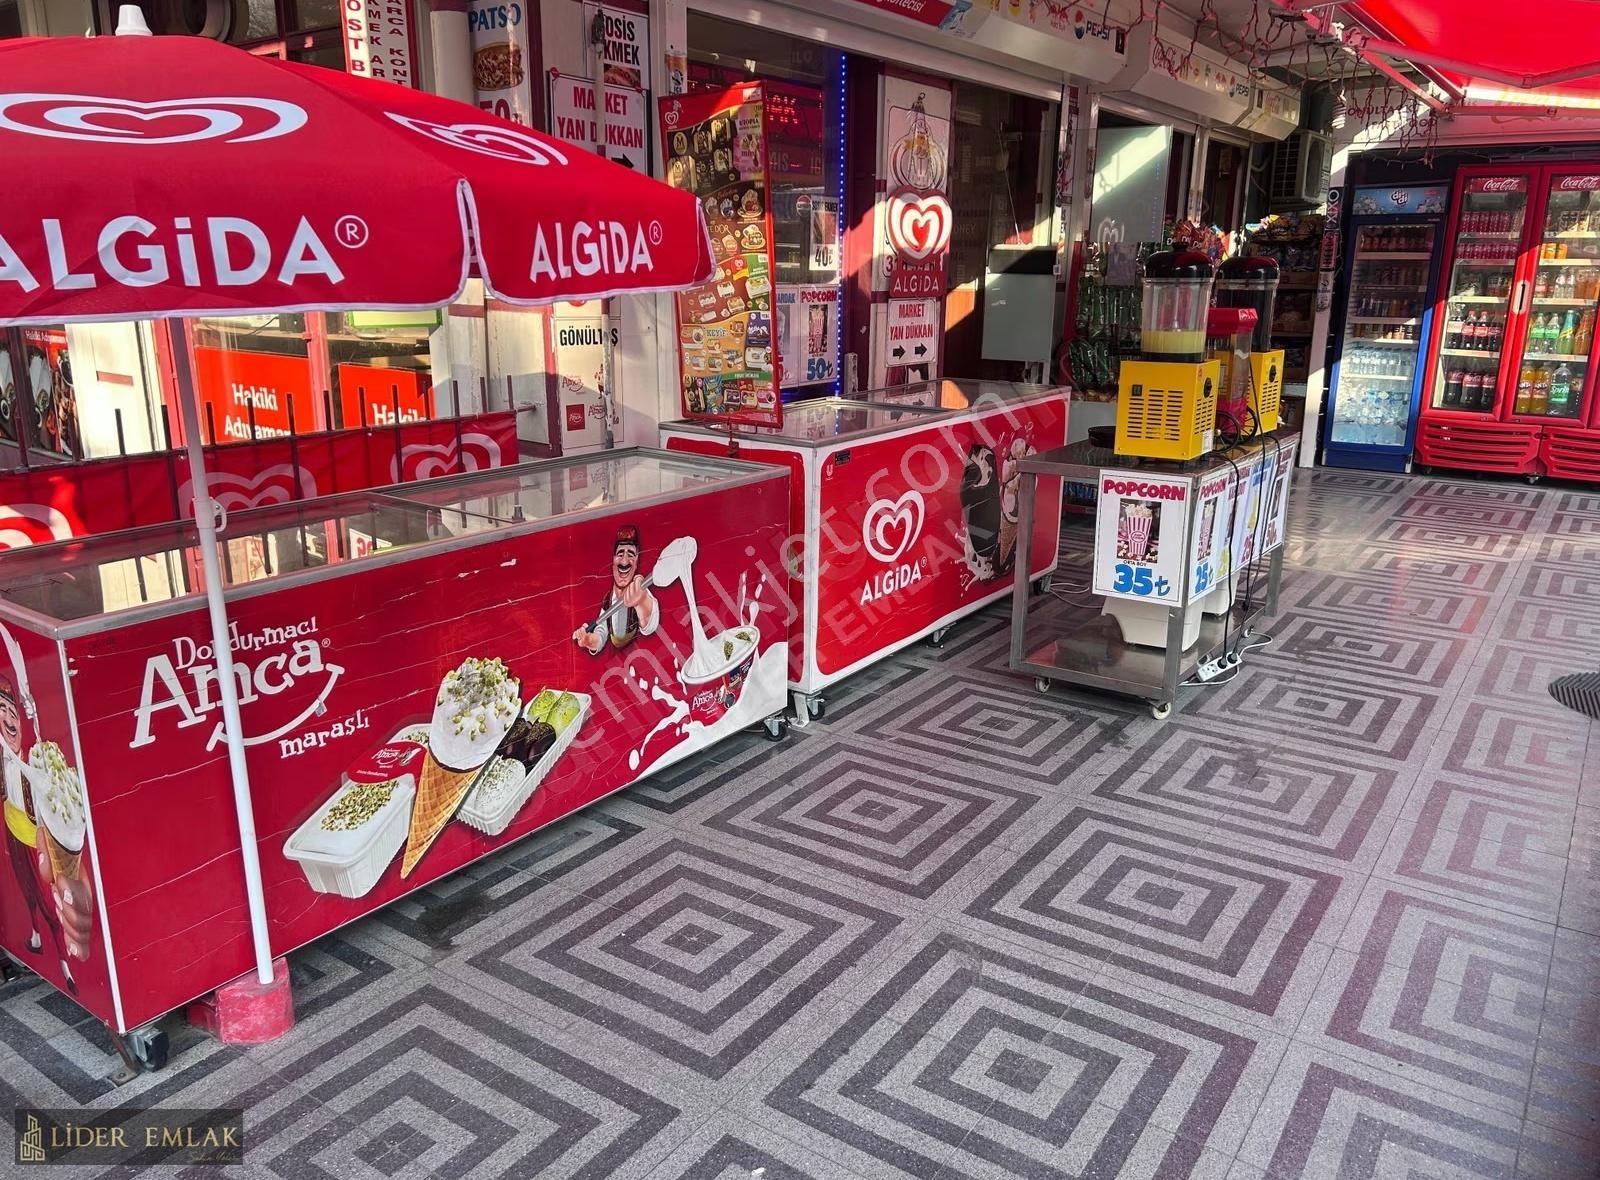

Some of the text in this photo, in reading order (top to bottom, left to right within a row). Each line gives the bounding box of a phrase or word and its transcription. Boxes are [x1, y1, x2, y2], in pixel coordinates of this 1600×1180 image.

[468, 3, 521, 32] PATSO
[604, 16, 635, 41] OSİS
[1086, 21, 1111, 40] PEPSI
[604, 40, 640, 65] KMEK
[573, 86, 628, 115] MAKET
[557, 117, 643, 148] YAN DKKAN
[801, 290, 837, 303] POPCORN
[899, 304, 925, 318] MARKET
[559, 325, 618, 347] GÖNÜLTŞ
[890, 321, 934, 340] YAN DÜKKAN
[232, 384, 278, 411] Hakiki
[1103, 480, 1186, 501] POPCORN
[1200, 478, 1228, 498] POPCORN
[172, 616, 319, 670] Dodurmacı
[129, 638, 325, 748] Amca
[278, 709, 370, 759] maraşlı
